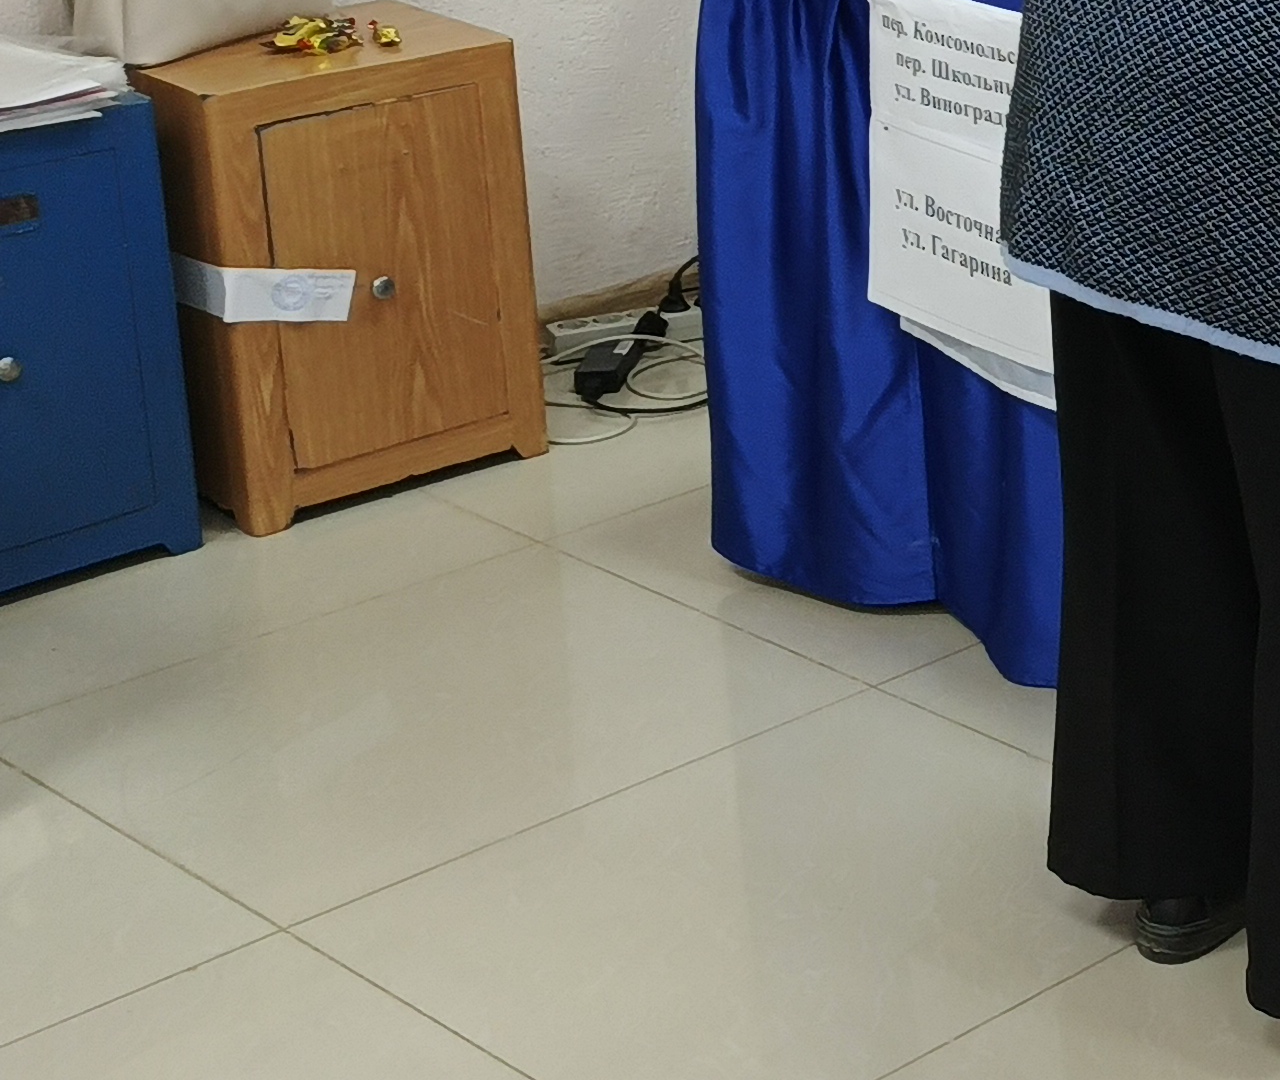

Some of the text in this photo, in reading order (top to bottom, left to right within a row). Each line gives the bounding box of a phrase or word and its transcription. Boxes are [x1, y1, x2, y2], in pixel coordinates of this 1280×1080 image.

[881, 13, 908, 40] пер.
[896, 51, 927, 77] пер.
[893, 83, 917, 104] ул.
[894, 187, 920, 213] ул.
[901, 226, 1013, 287] ул. Гагарина
